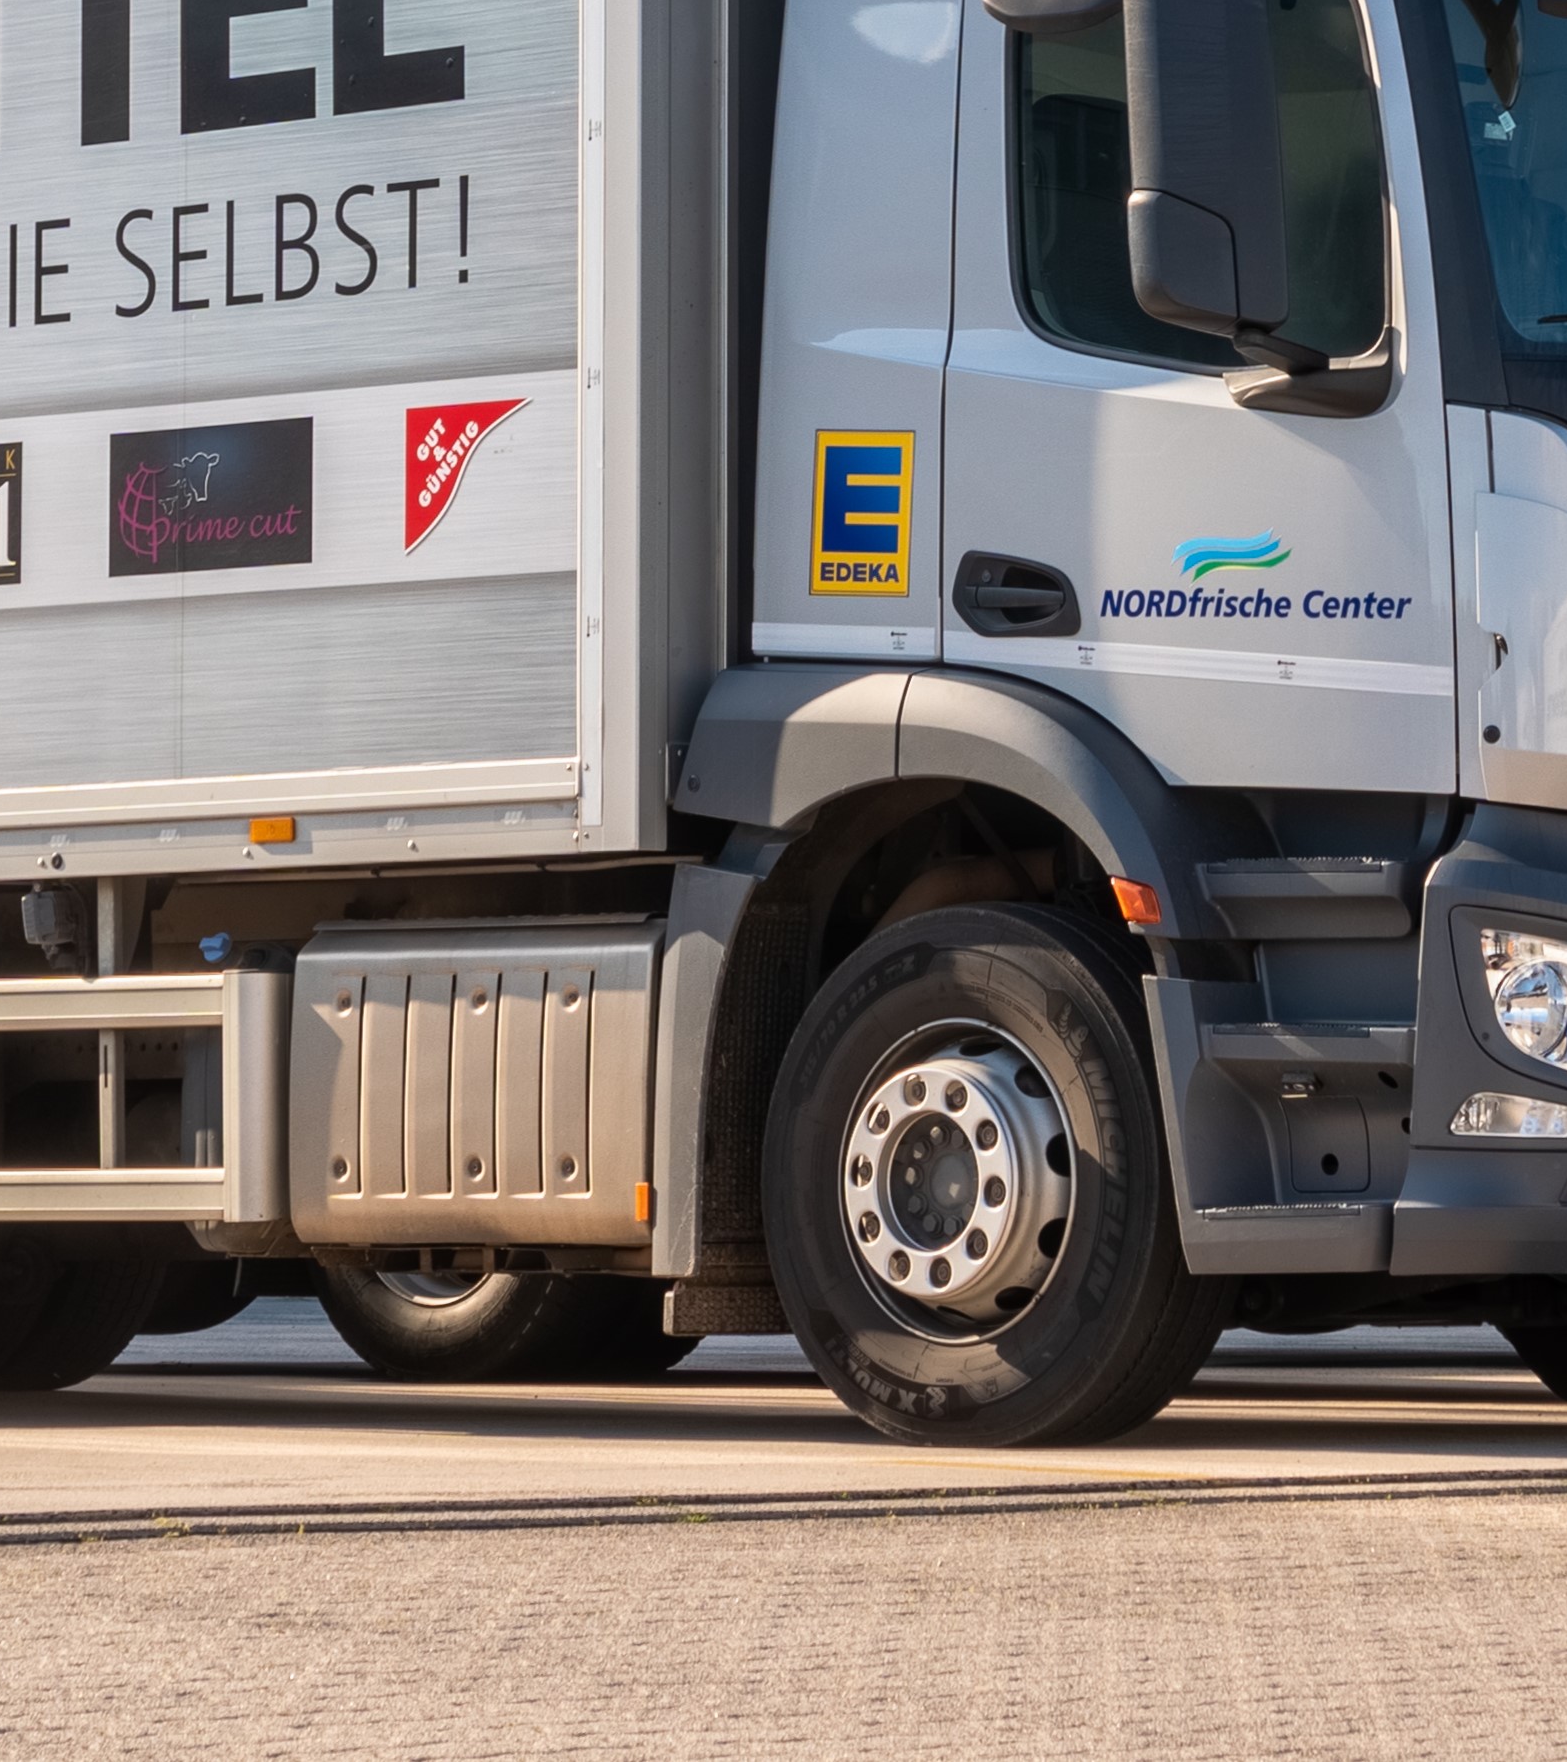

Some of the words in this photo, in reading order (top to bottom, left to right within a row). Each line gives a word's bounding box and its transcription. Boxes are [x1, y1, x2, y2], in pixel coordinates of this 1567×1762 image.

[115, 175, 471, 318] SELBST!
[417, 418, 446, 461] GUT
[419, 421, 480, 508] GÜNSTIG
[250, 504, 302, 536] cut
[820, 562, 900, 583] EDEKA
[1101, 588, 1291, 619] NORDfrische
[1303, 589, 1412, 619] Center
[1083, 1058, 1127, 1304] MICHELIN
